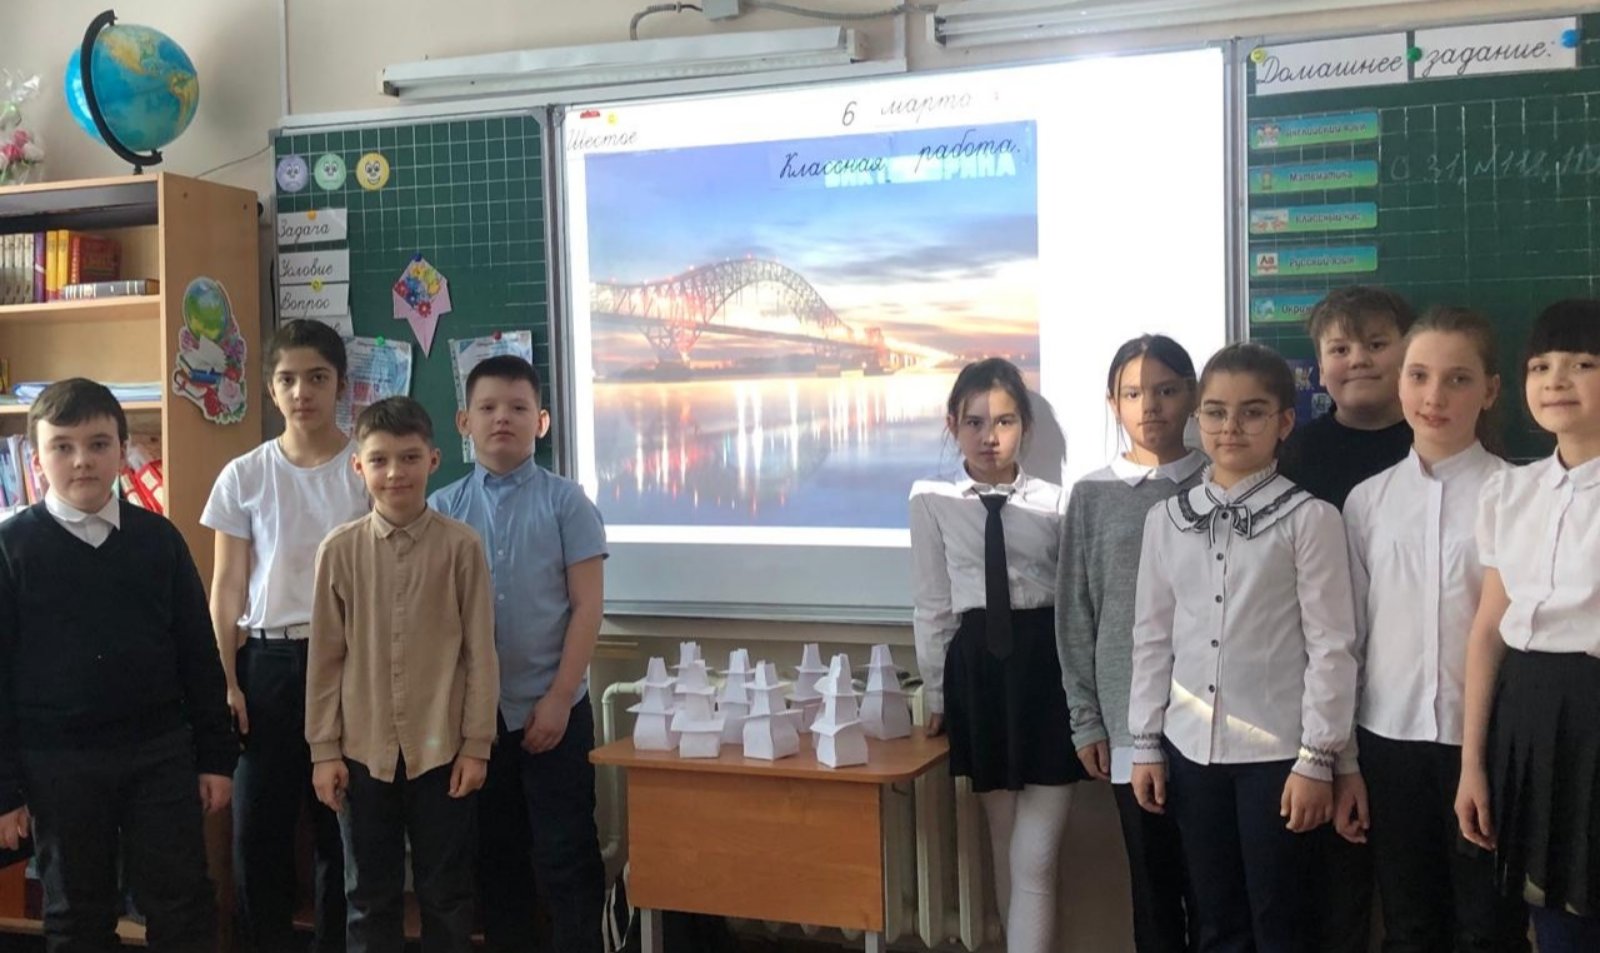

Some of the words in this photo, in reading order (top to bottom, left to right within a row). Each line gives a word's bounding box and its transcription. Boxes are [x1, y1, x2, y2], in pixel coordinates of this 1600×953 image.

[1256, 55, 1403, 85] Домашнее
[1421, 40, 1552, 78] задание:
[841, 101, 857, 126] 6
[566, 128, 637, 152] Шестое
[779, 152, 884, 179] Классная
[914, 128, 1021, 174] работа.
[279, 218, 330, 244] Задача
[280, 257, 333, 277] Условие
[280, 292, 330, 318] Вопрос
